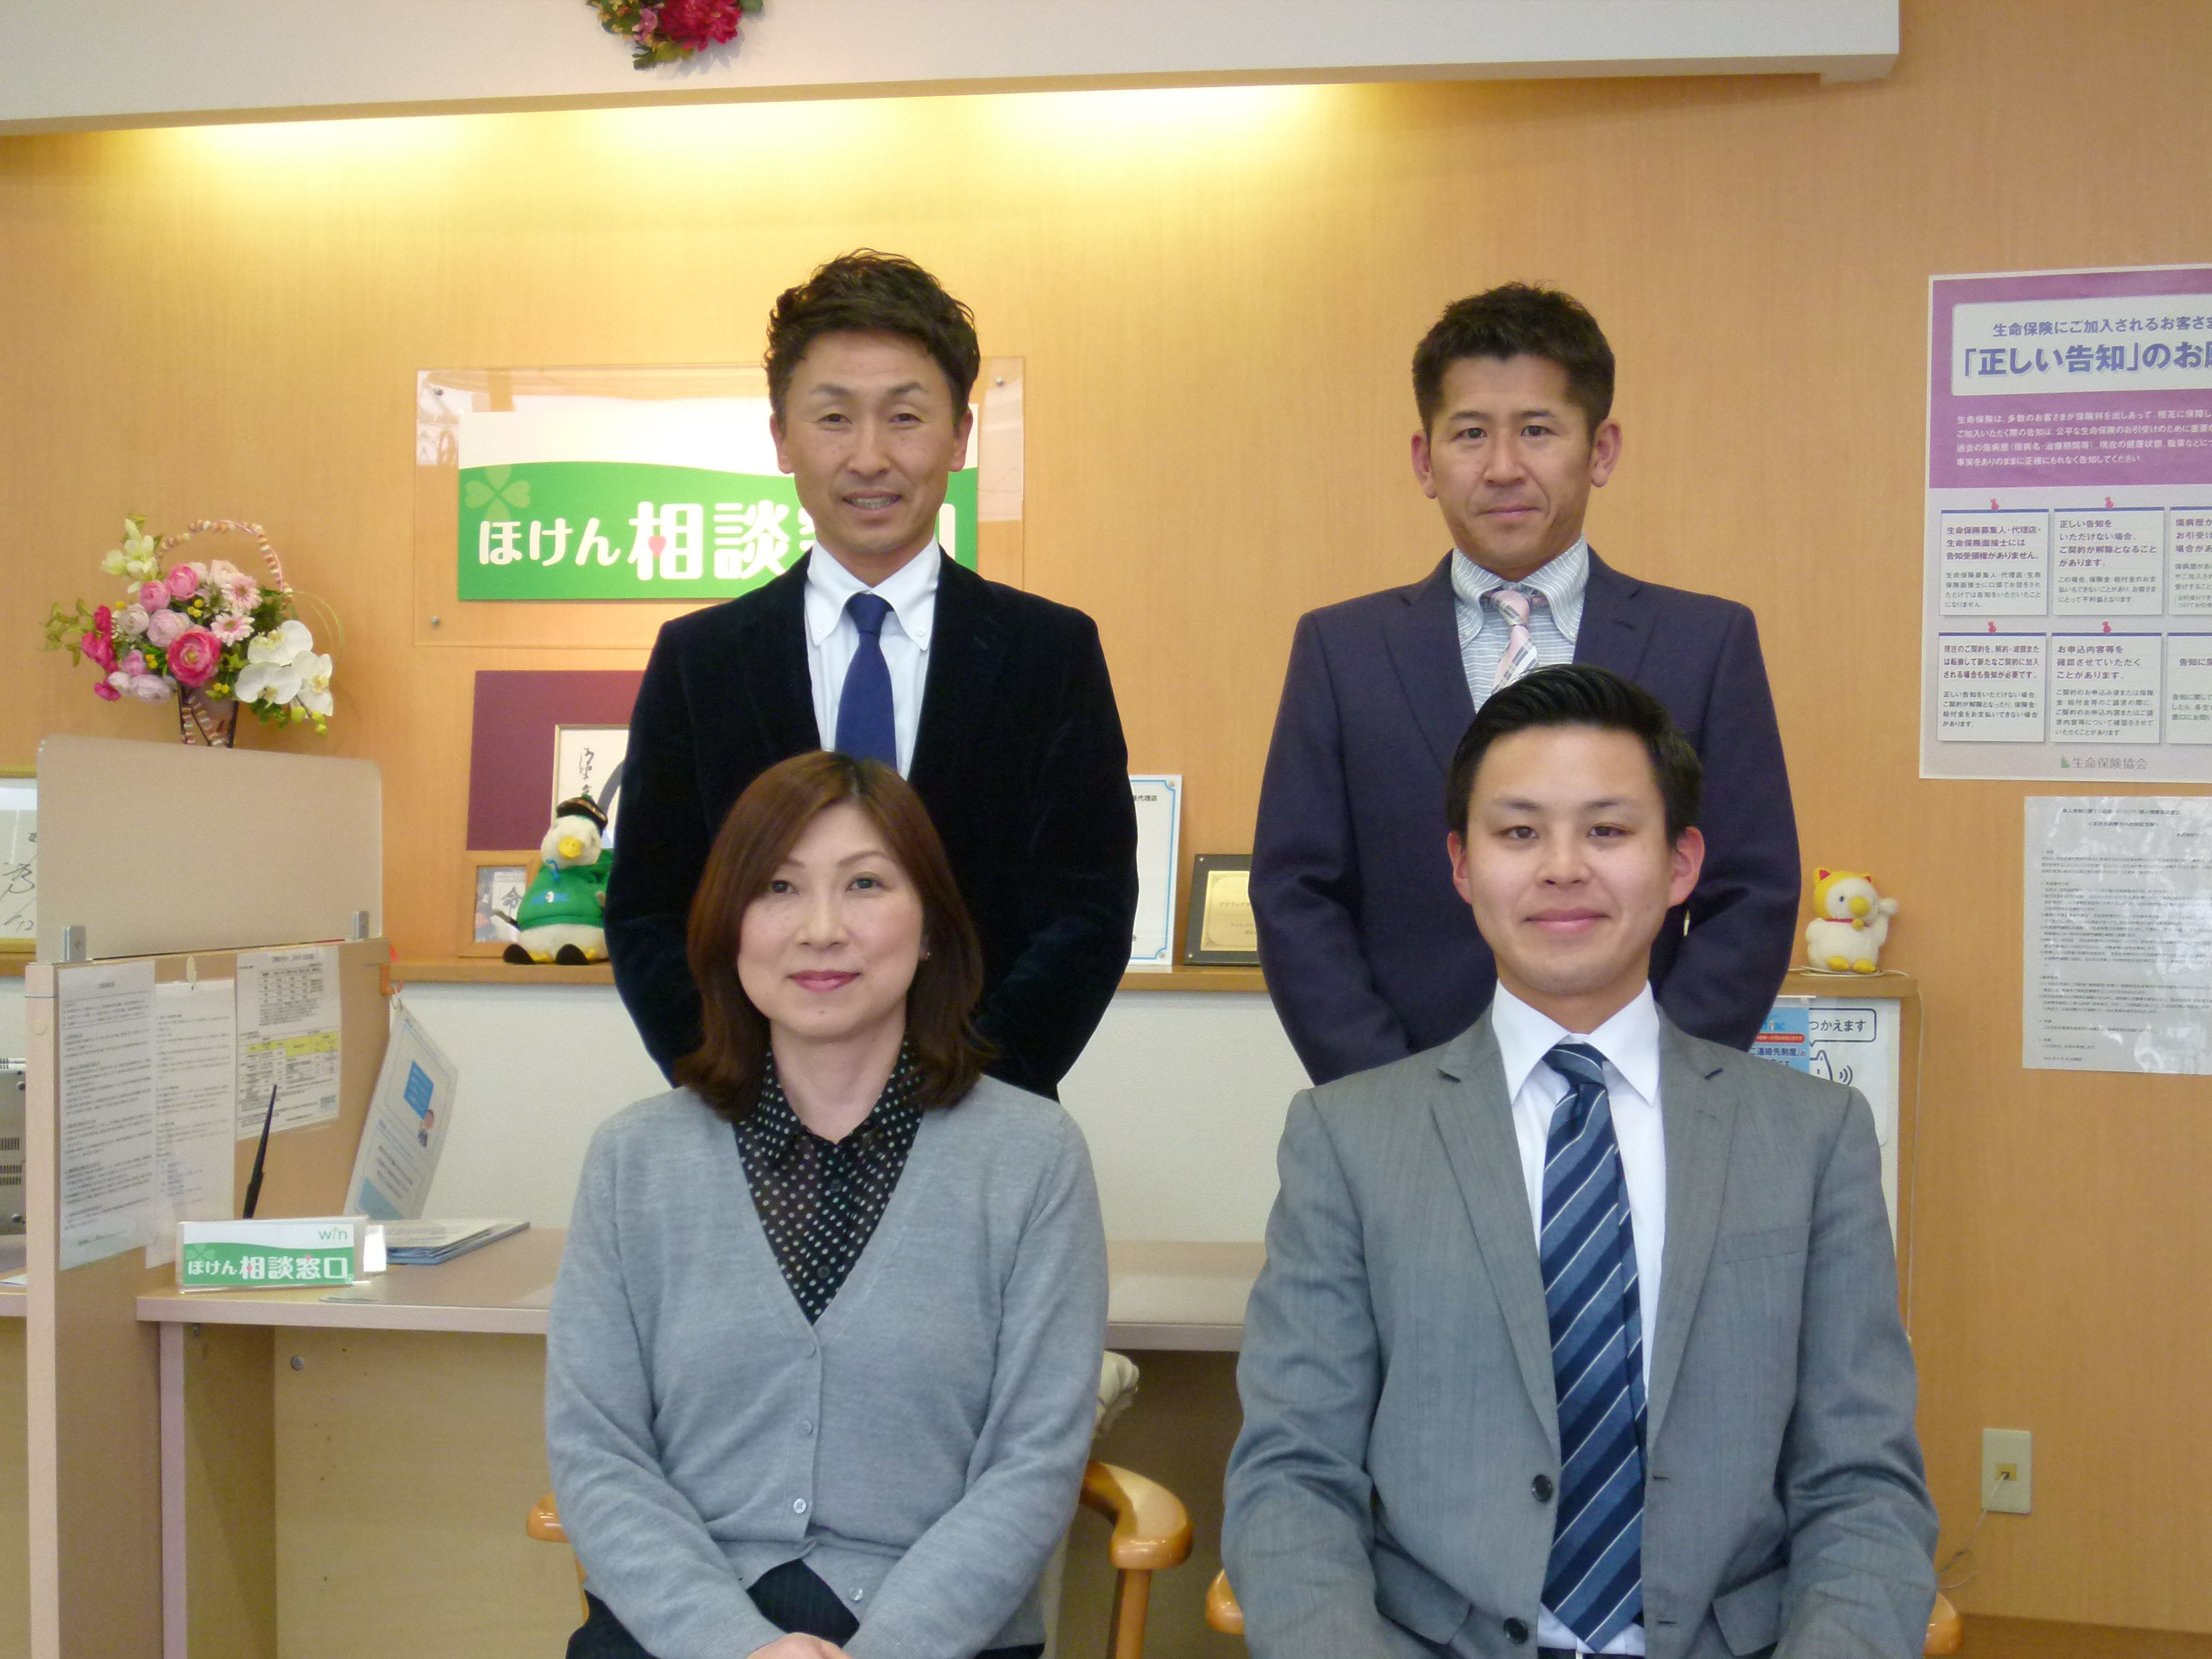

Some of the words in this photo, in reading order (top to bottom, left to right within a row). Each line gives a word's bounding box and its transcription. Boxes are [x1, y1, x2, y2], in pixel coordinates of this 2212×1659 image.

[1965, 341, 2212, 376] 「正しい告知」のお
[2059, 520, 2112, 528] 正しい告知を
[479, 500, 955, 581] ほけん相談
[2057, 645, 2123, 654] お申込内容等を
[2057, 658, 2141, 667] 確認させていただく
[2073, 757, 2146, 770] 生命保険協会
[187, 1255, 348, 1280] ほけん相談窓口
